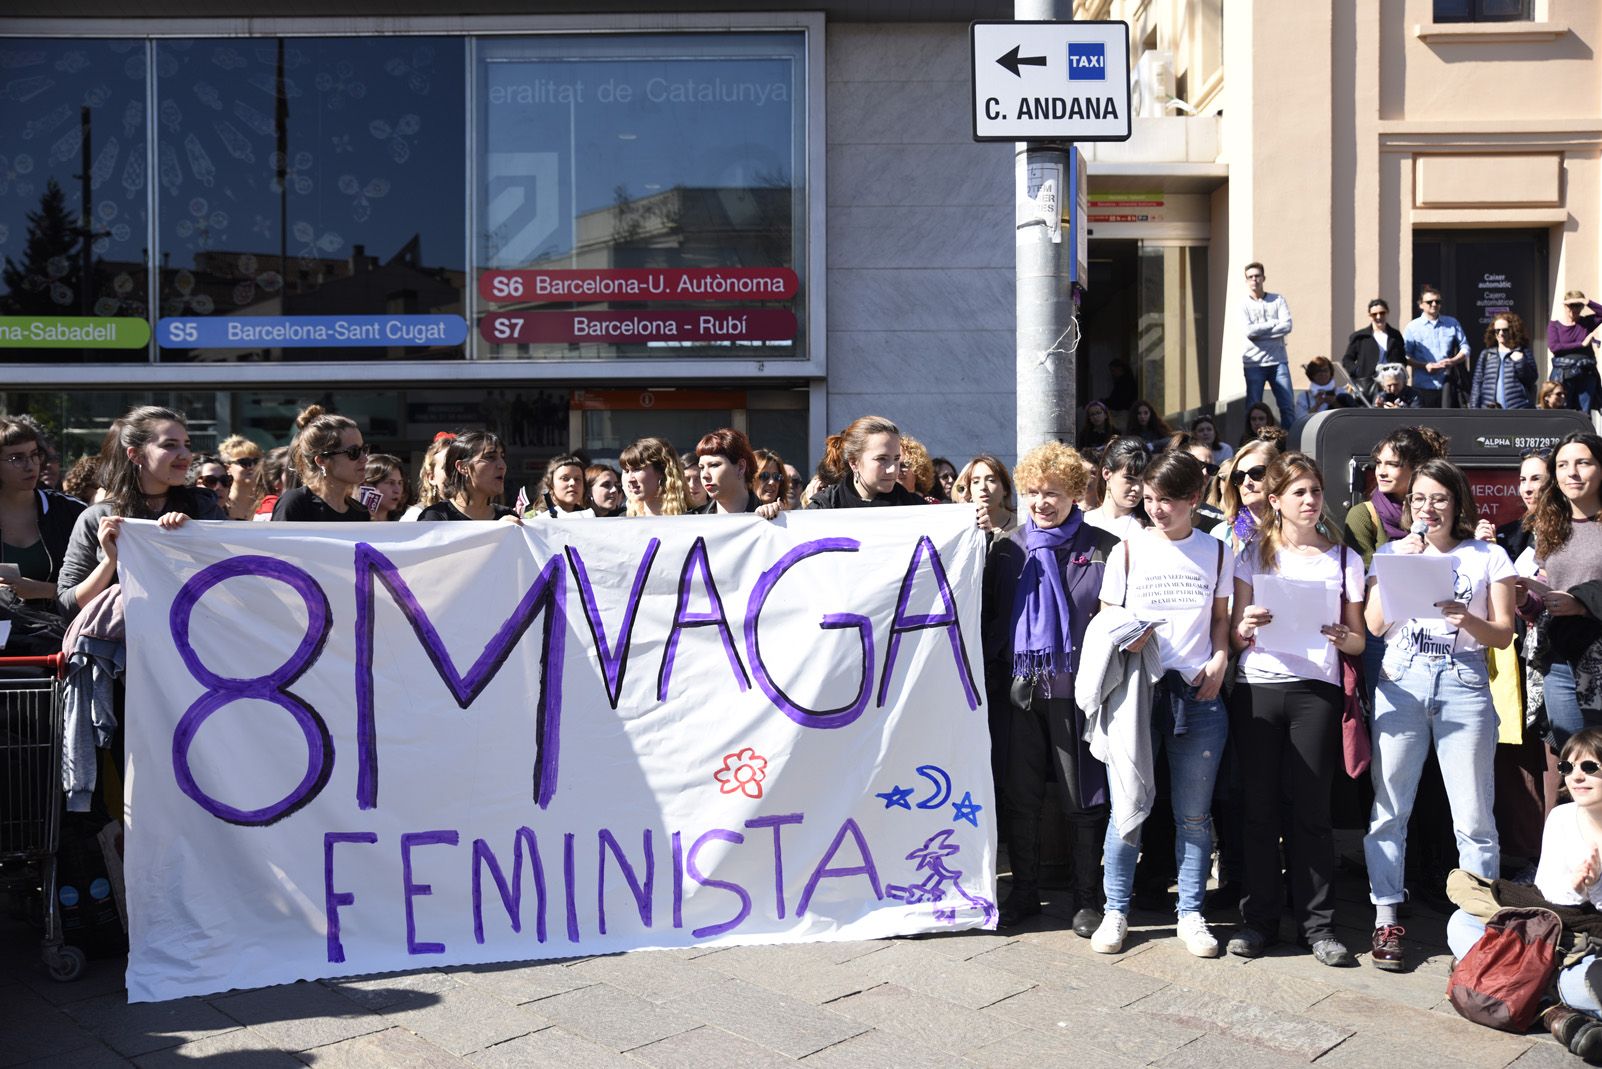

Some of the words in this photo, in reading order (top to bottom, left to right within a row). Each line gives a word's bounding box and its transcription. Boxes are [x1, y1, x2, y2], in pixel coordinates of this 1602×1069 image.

[1069, 55, 1104, 68] TAXI
[597, 78, 633, 103] de
[646, 77, 788, 106] Catalunya
[984, 97, 1008, 121] C.
[1016, 97, 1119, 121] ANDANA
[492, 277, 524, 297] S6
[535, 275, 671, 295] Barcelona-U.
[677, 272, 785, 294] Autònoma
[1484, 273, 1506, 281] Caixer
[0, 322, 117, 341] na-Sabadell
[169, 322, 198, 342] S5
[227, 321, 380, 341] Barcelona-Sant
[385, 320, 446, 344] Cugat
[494, 318, 525, 339] S7
[573, 317, 678, 337] Barcelona
[699, 315, 747, 335] Rubí
[1484, 438, 1511, 446] ALPHA
[566, 535, 982, 730] VAGA
[324, 812, 884, 964] FEMINISTA
